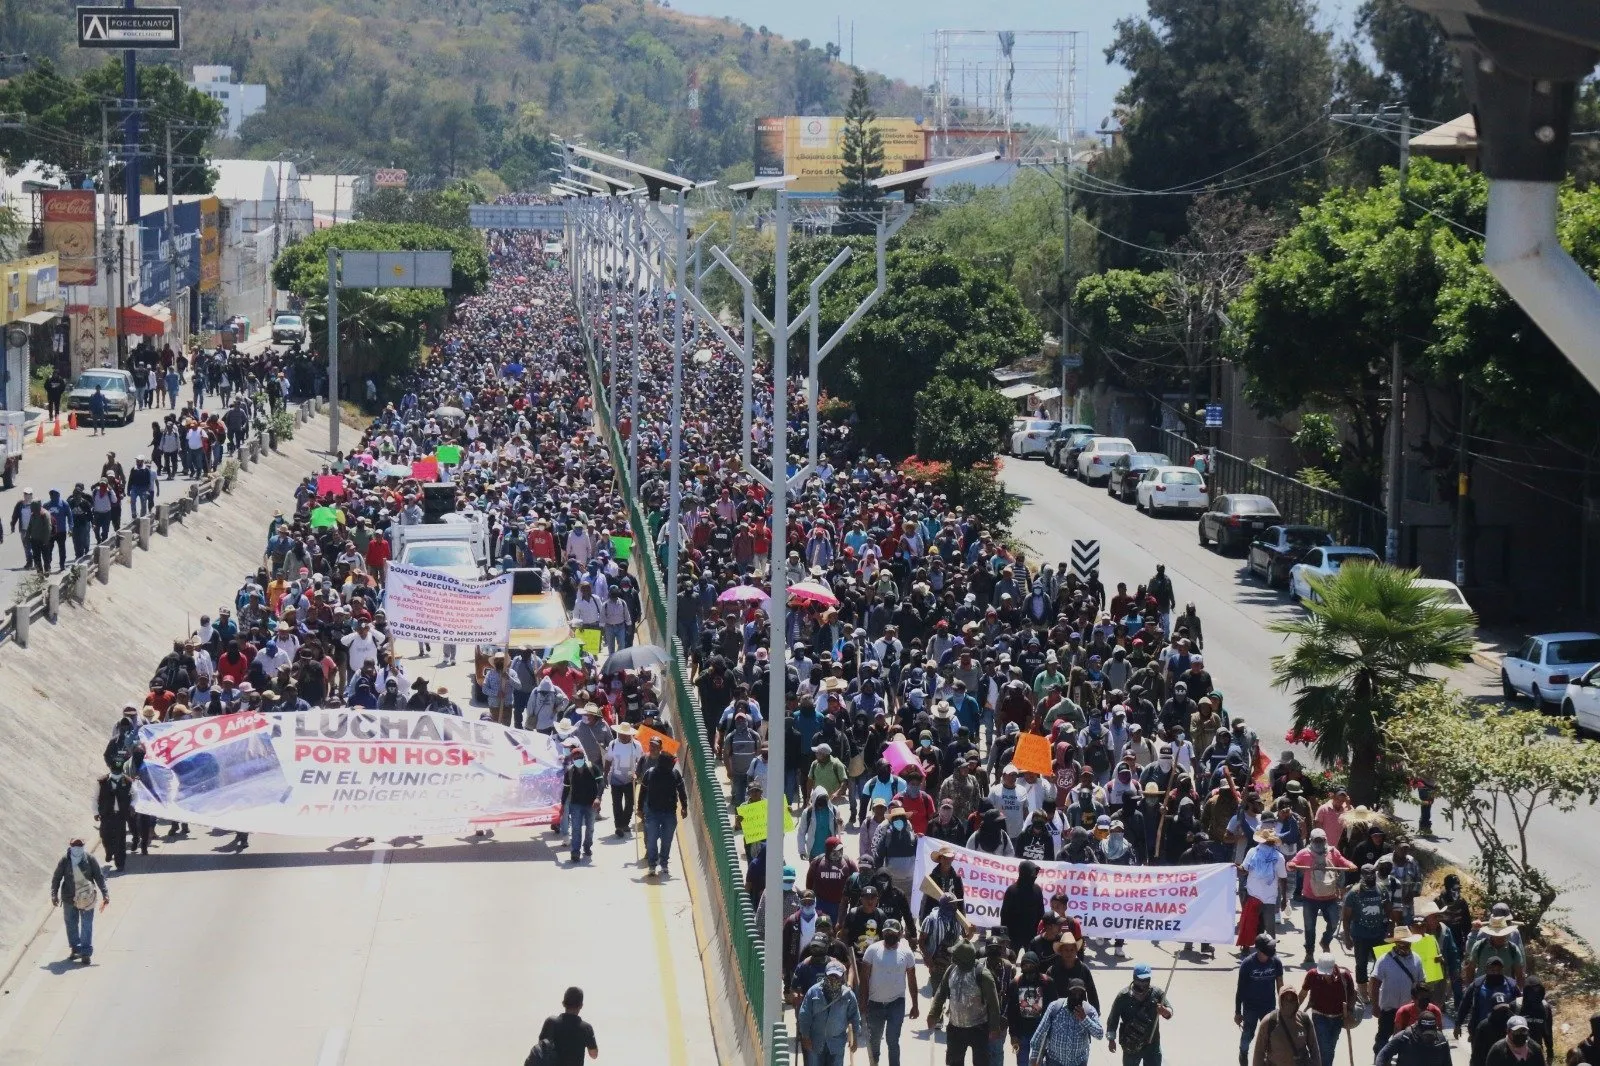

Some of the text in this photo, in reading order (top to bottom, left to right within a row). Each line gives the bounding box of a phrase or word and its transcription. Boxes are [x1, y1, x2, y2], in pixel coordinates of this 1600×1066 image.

[375, 173, 404, 182] OXXO
[390, 565, 418, 577] SOMOS
[421, 571, 459, 585] PUEBLOS
[412, 592, 481, 606] CLAUDIA SHEINBAUM
[449, 592, 490, 600] PRESIDENTA
[397, 601, 444, 614] PRODUCTORES
[425, 601, 469, 611] INTEGRANDO
[427, 614, 472, 623] FERTILIZANTE
[392, 629, 411, 637] SOLO
[413, 632, 440, 640] SOMOS
[400, 623, 440, 634] ROBAMOS,
[295, 713, 520, 747] LUCHAND
[168, 722, 221, 758] 20
[294, 745, 536, 766] POR UN HOSPL
[300, 770, 331, 784] EN
[336, 771, 362, 785] EL
[332, 786, 428, 801] INDÍGENA
[820, 871, 841, 879] PUMA
[973, 856, 1020, 873] REGIO
[1114, 872, 1152, 884] BAJA
[1156, 872, 1197, 883] EXIGE
[1070, 885, 1088, 896] DE
[1093, 887, 1110, 898] LA
[1114, 886, 1198, 898] DIRECTORA
[963, 885, 1187, 915] REGIO OS PROGRAMAS
[1102, 915, 1181, 931] GUTIÉRREZ
